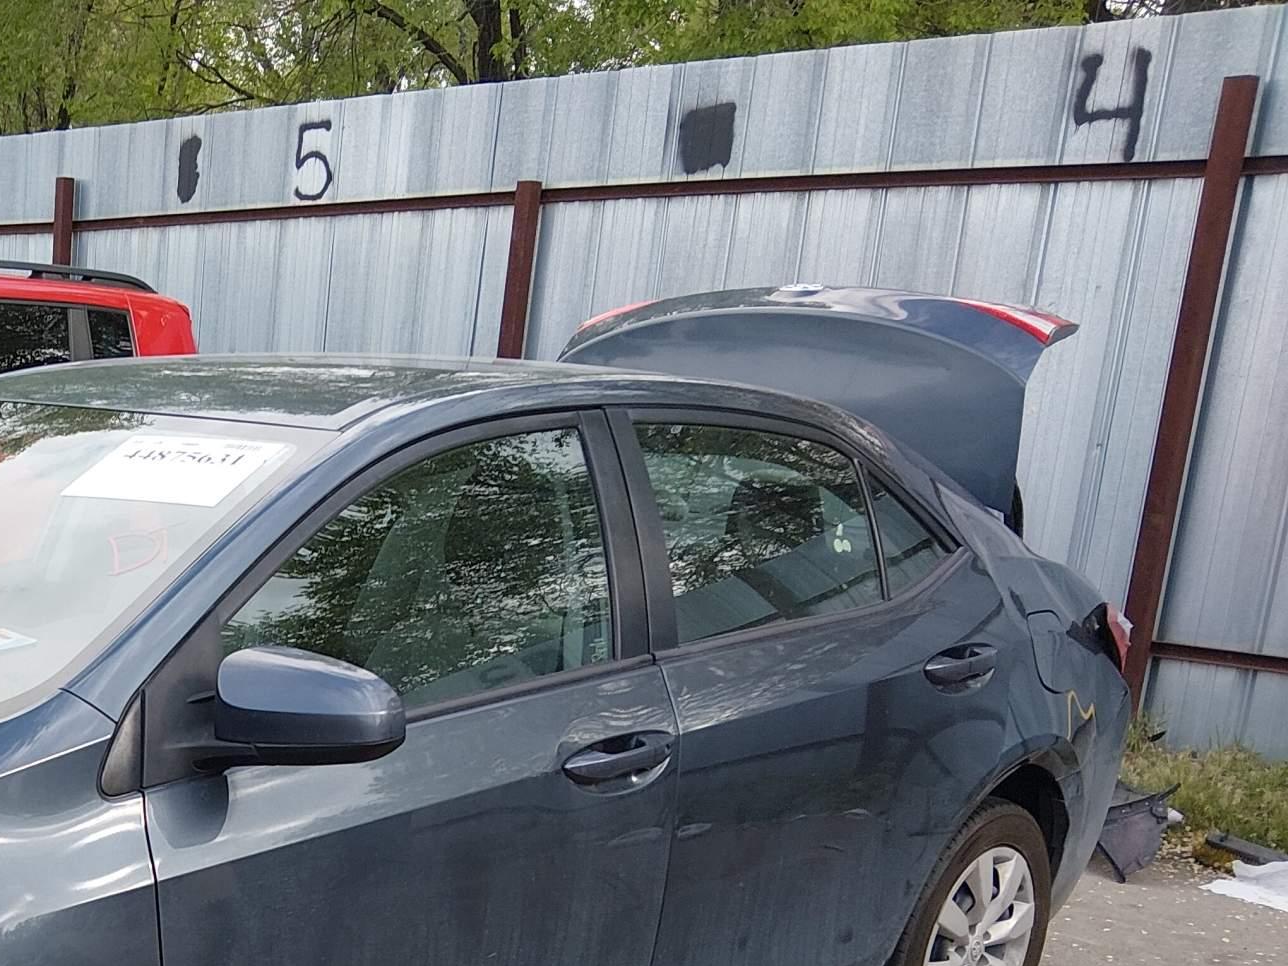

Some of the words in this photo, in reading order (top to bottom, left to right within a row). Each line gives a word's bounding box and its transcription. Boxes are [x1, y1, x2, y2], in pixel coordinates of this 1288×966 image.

[1074, 47, 1152, 161] 4
[294, 119, 333, 201] 5
[122, 449, 246, 466] 44875631
